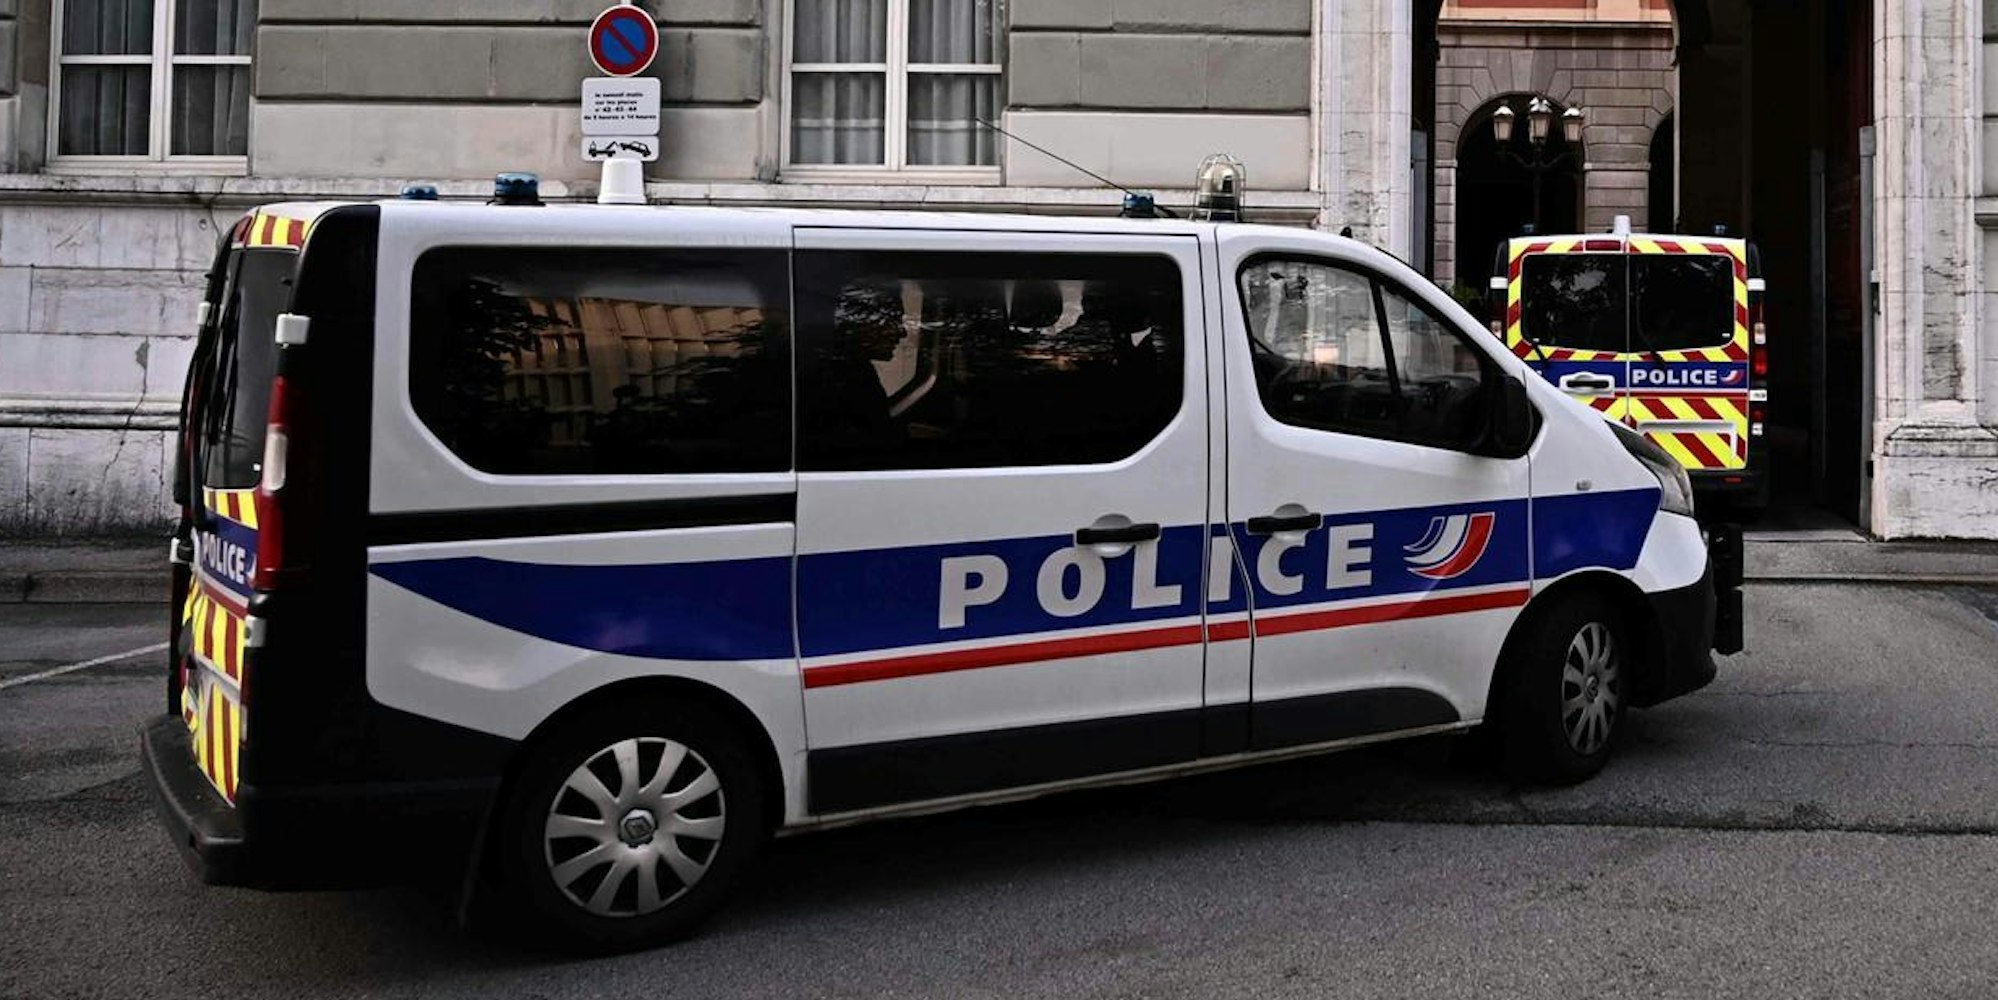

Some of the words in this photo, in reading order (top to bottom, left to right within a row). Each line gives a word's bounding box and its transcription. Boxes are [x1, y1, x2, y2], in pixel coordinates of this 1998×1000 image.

[1632, 369, 1718, 385] POLICE
[202, 531, 245, 584] POLICE
[938, 523, 1375, 630] POLICE
